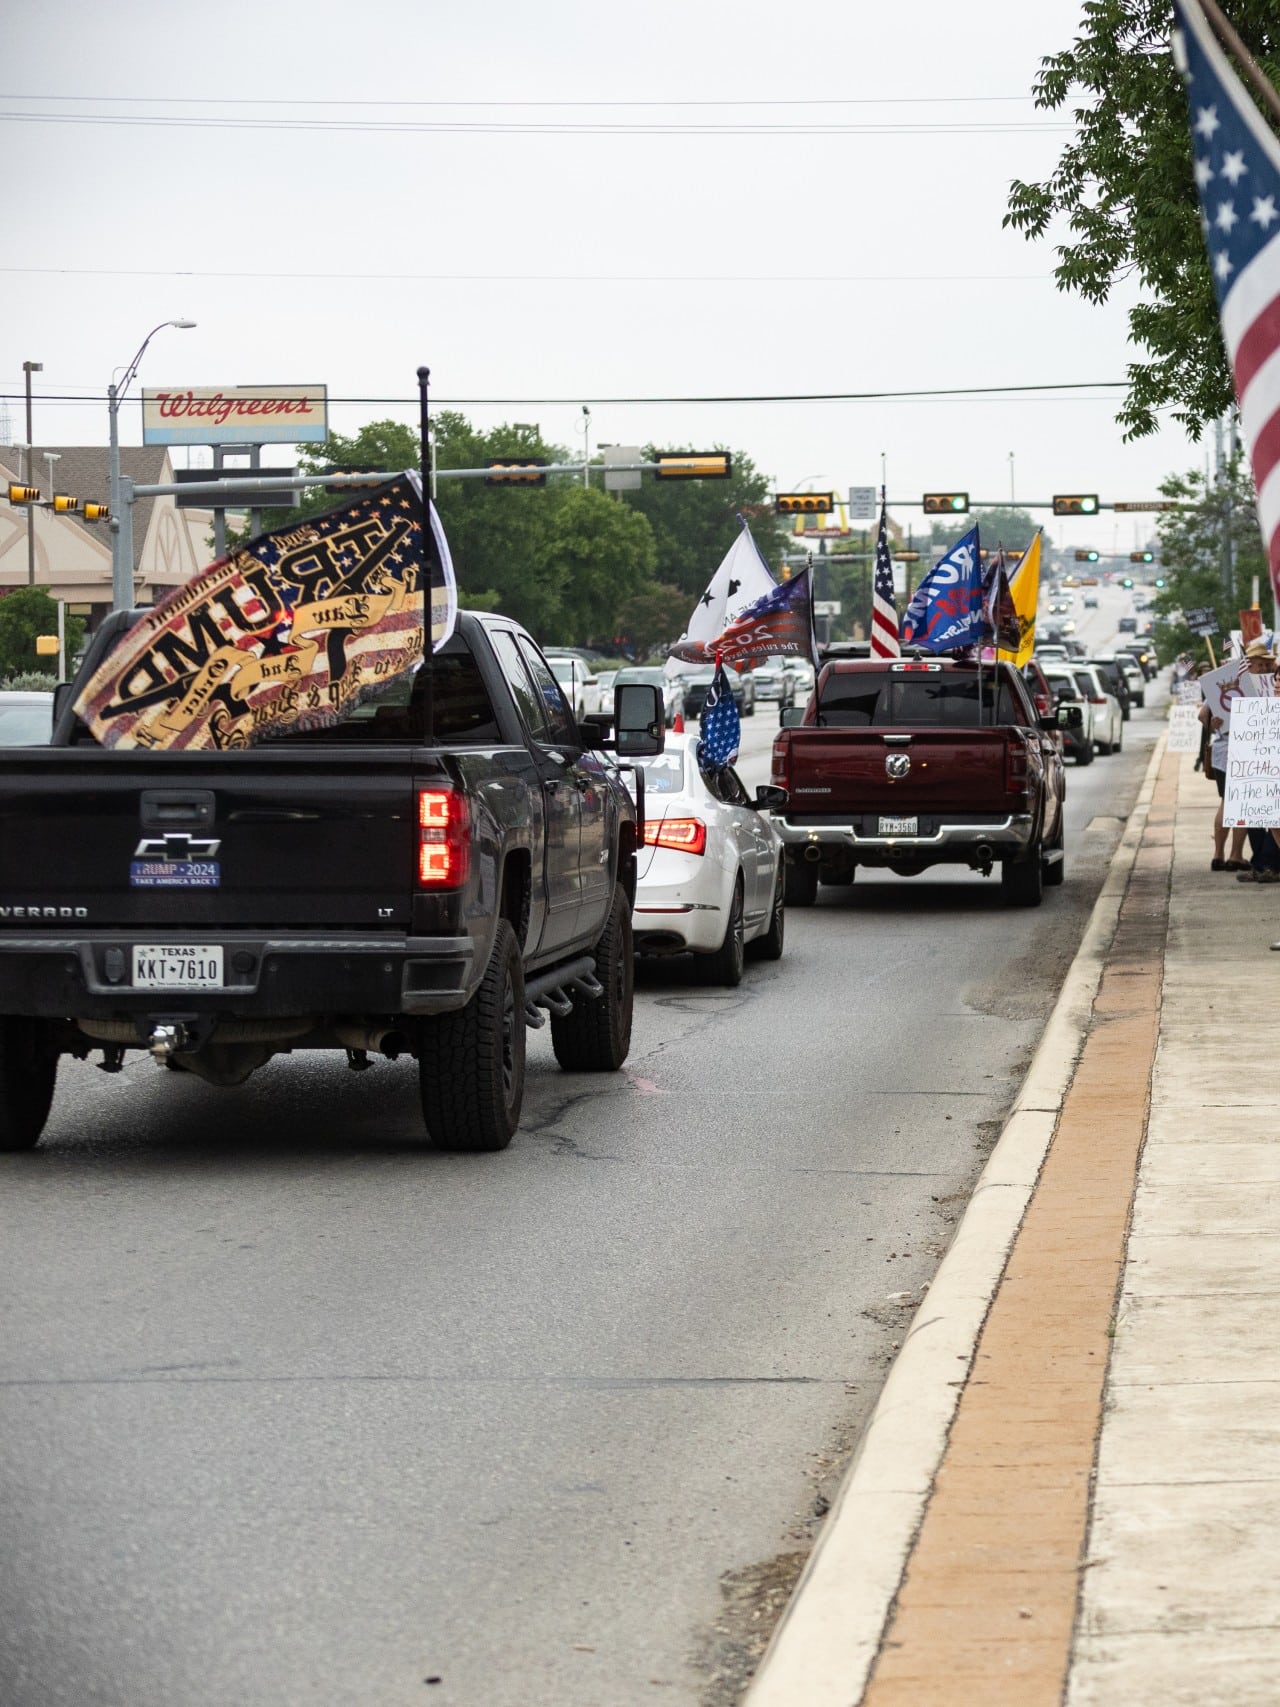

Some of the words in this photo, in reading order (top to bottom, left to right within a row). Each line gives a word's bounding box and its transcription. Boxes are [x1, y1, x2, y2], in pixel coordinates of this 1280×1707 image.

[156, 391, 313, 425] Walgreens
[1241, 784, 1262, 799] the
[137, 864, 177, 875] TRUMP
[186, 864, 216, 876] 2024
[378, 908, 394, 917] LT
[161, 948, 196, 956] TEXAS
